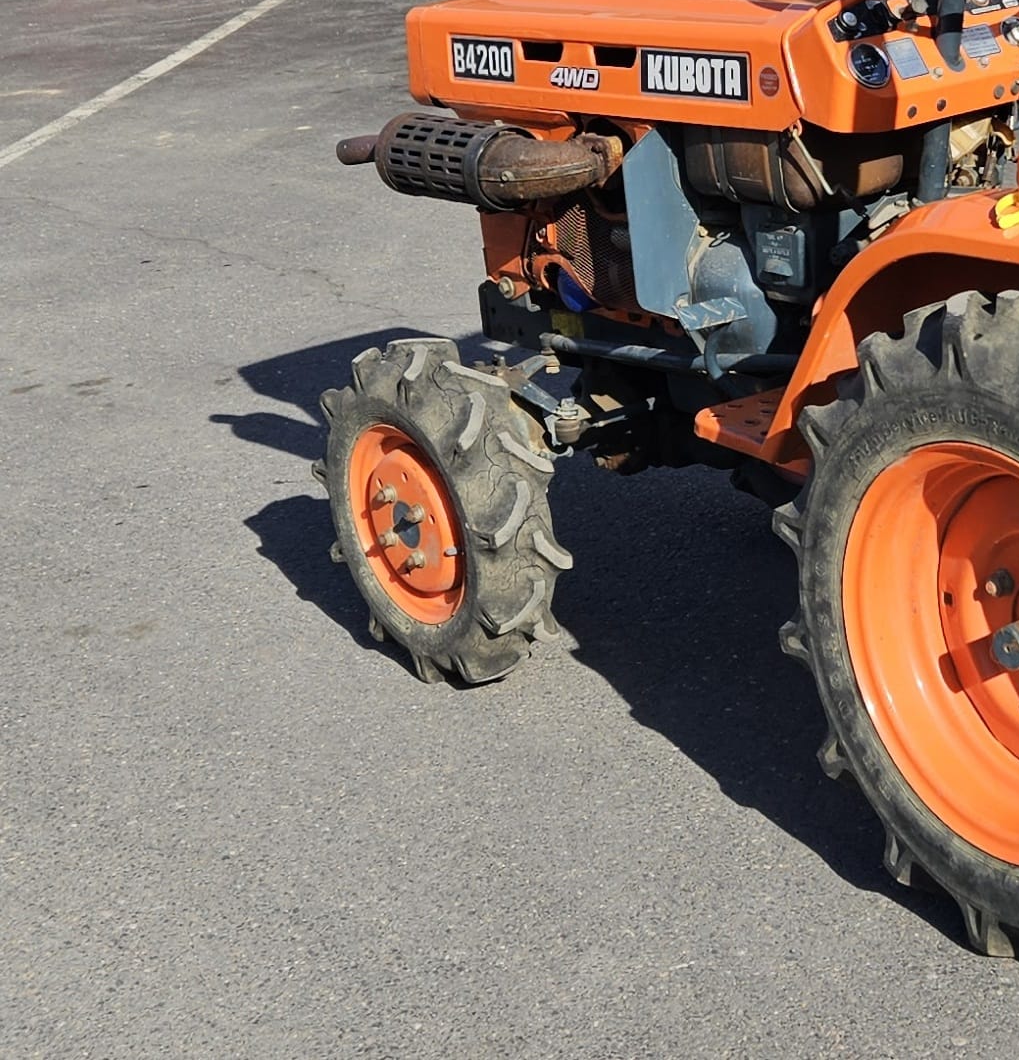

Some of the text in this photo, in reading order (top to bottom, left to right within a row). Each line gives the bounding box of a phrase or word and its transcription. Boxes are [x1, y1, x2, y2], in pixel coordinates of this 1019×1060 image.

[453, 42, 513, 78] B4200
[550, 67, 600, 89] 4WD
[647, 54, 741, 96] KUBOTA
